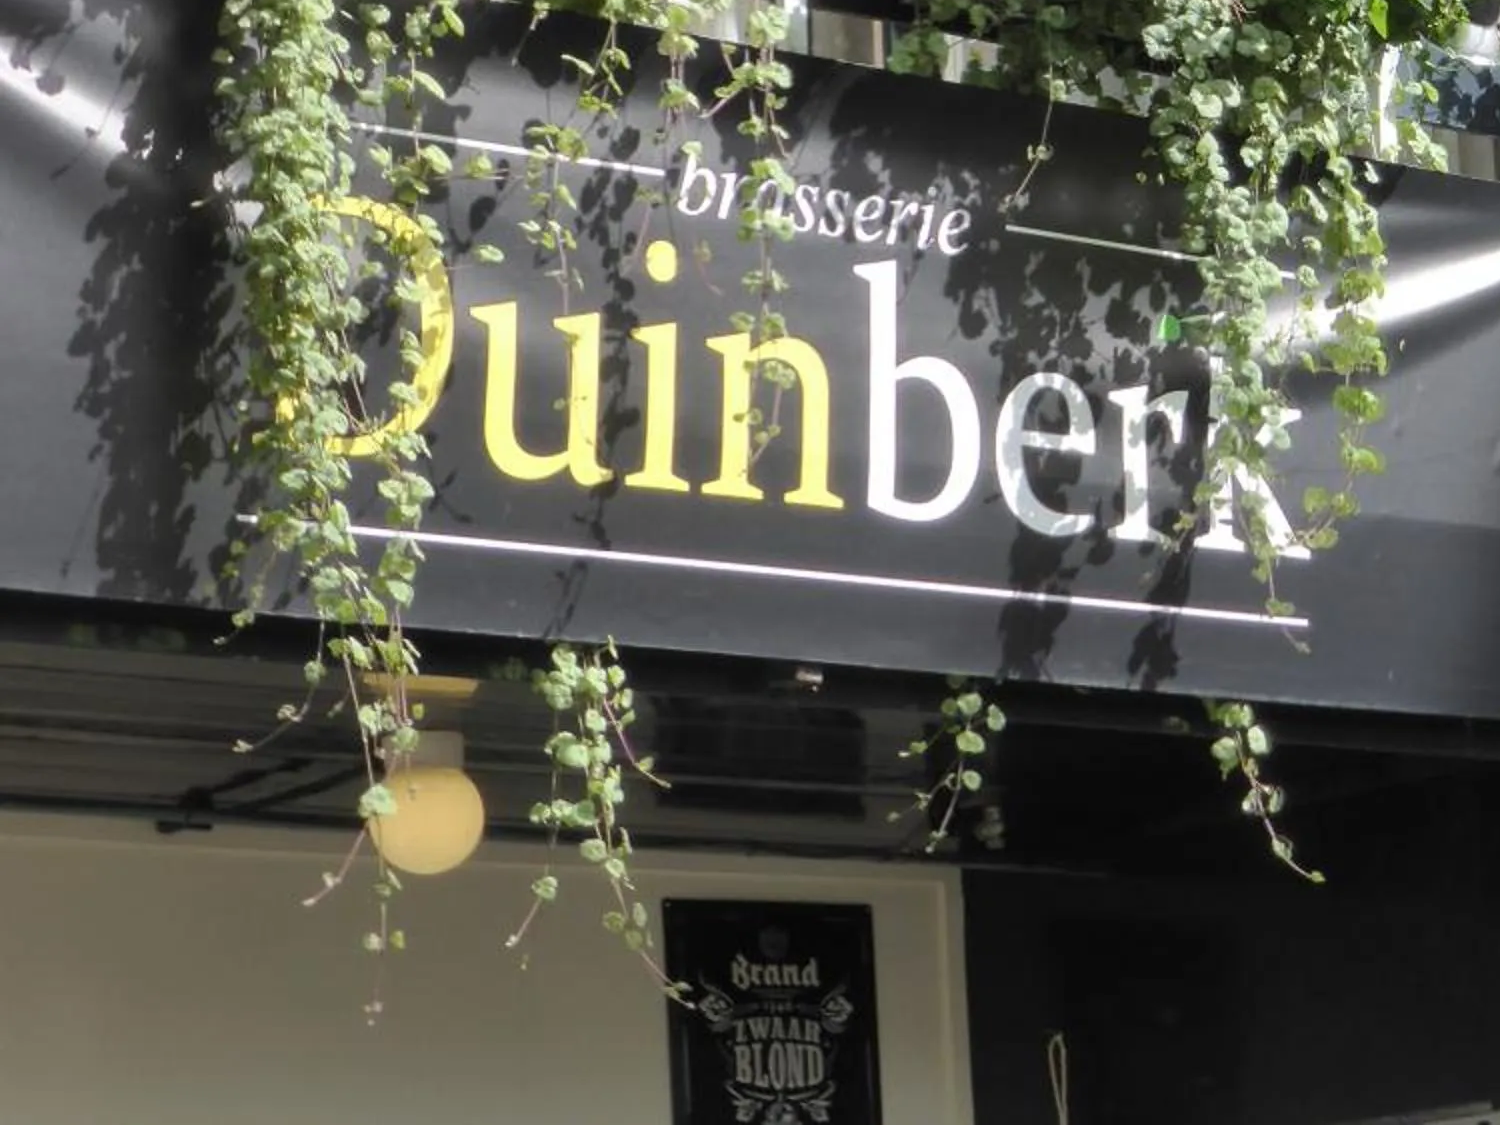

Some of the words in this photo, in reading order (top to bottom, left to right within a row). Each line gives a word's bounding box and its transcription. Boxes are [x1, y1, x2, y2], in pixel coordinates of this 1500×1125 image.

[677, 139, 972, 255] brasserie
[730, 953, 820, 990] Brand
[734, 1041, 825, 1090] BLOND
